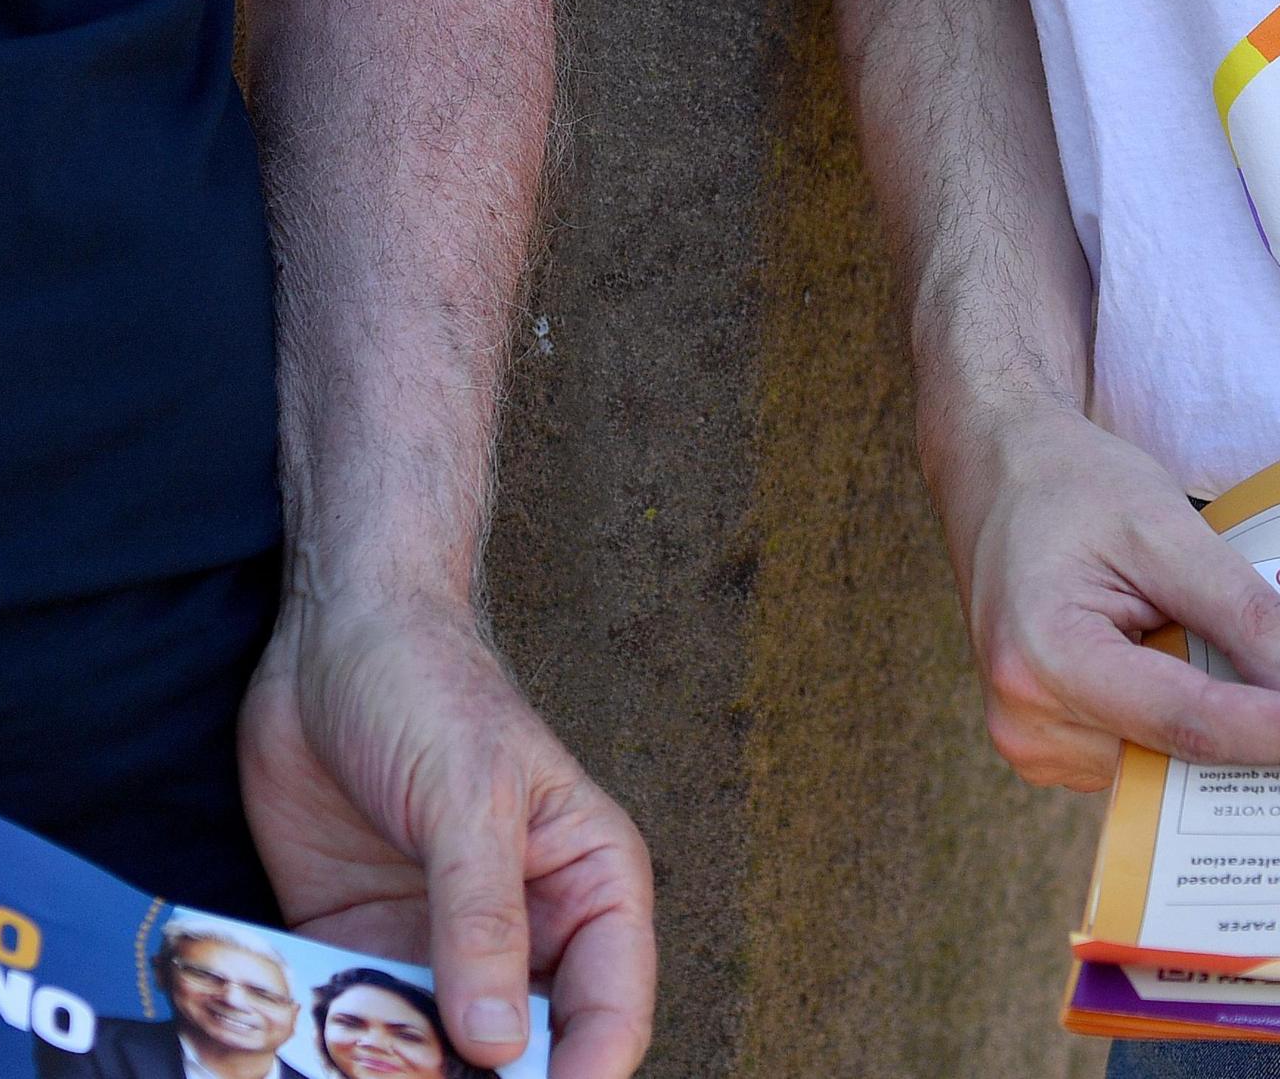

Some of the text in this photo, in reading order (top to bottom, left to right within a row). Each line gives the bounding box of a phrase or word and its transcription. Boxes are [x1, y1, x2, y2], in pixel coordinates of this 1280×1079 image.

[1199, 769, 1260, 781] question
[1199, 783, 1239, 795] space
[1242, 785, 1265, 795] the
[1214, 805, 1265, 818] VOTER
[1176, 873, 1263, 888] proposed
[1217, 921, 1277, 933] PAPER
